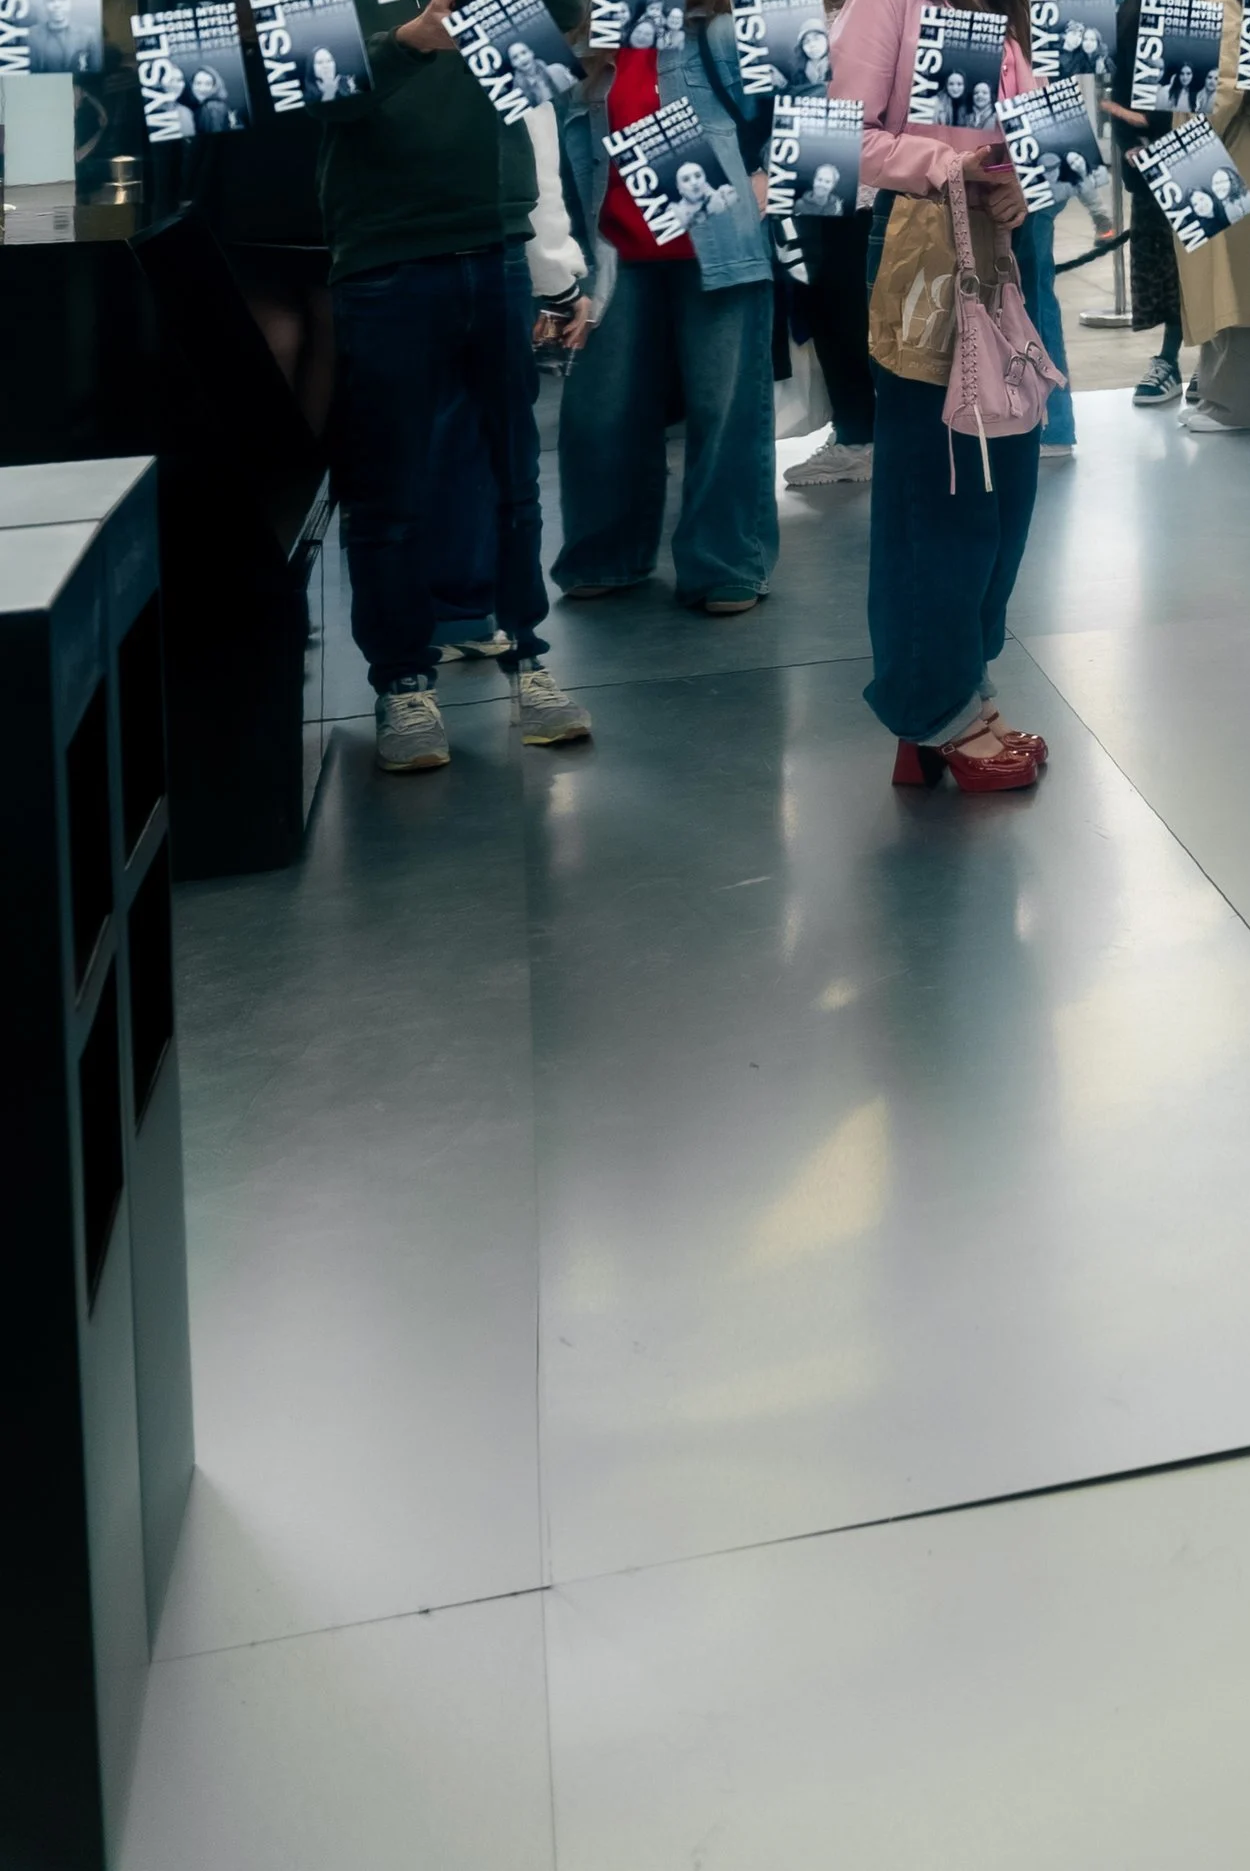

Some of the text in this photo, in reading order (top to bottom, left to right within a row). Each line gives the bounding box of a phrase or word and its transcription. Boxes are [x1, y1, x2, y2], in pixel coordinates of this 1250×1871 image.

[132, 13, 182, 143] MYSLF
[442, 5, 534, 125] MYSLF
[906, 6, 947, 125] MYSLF
[603, 126, 686, 246] MYSLF
[765, 96, 802, 215] MYSLF
[1131, 144, 1210, 255] MYSLF
